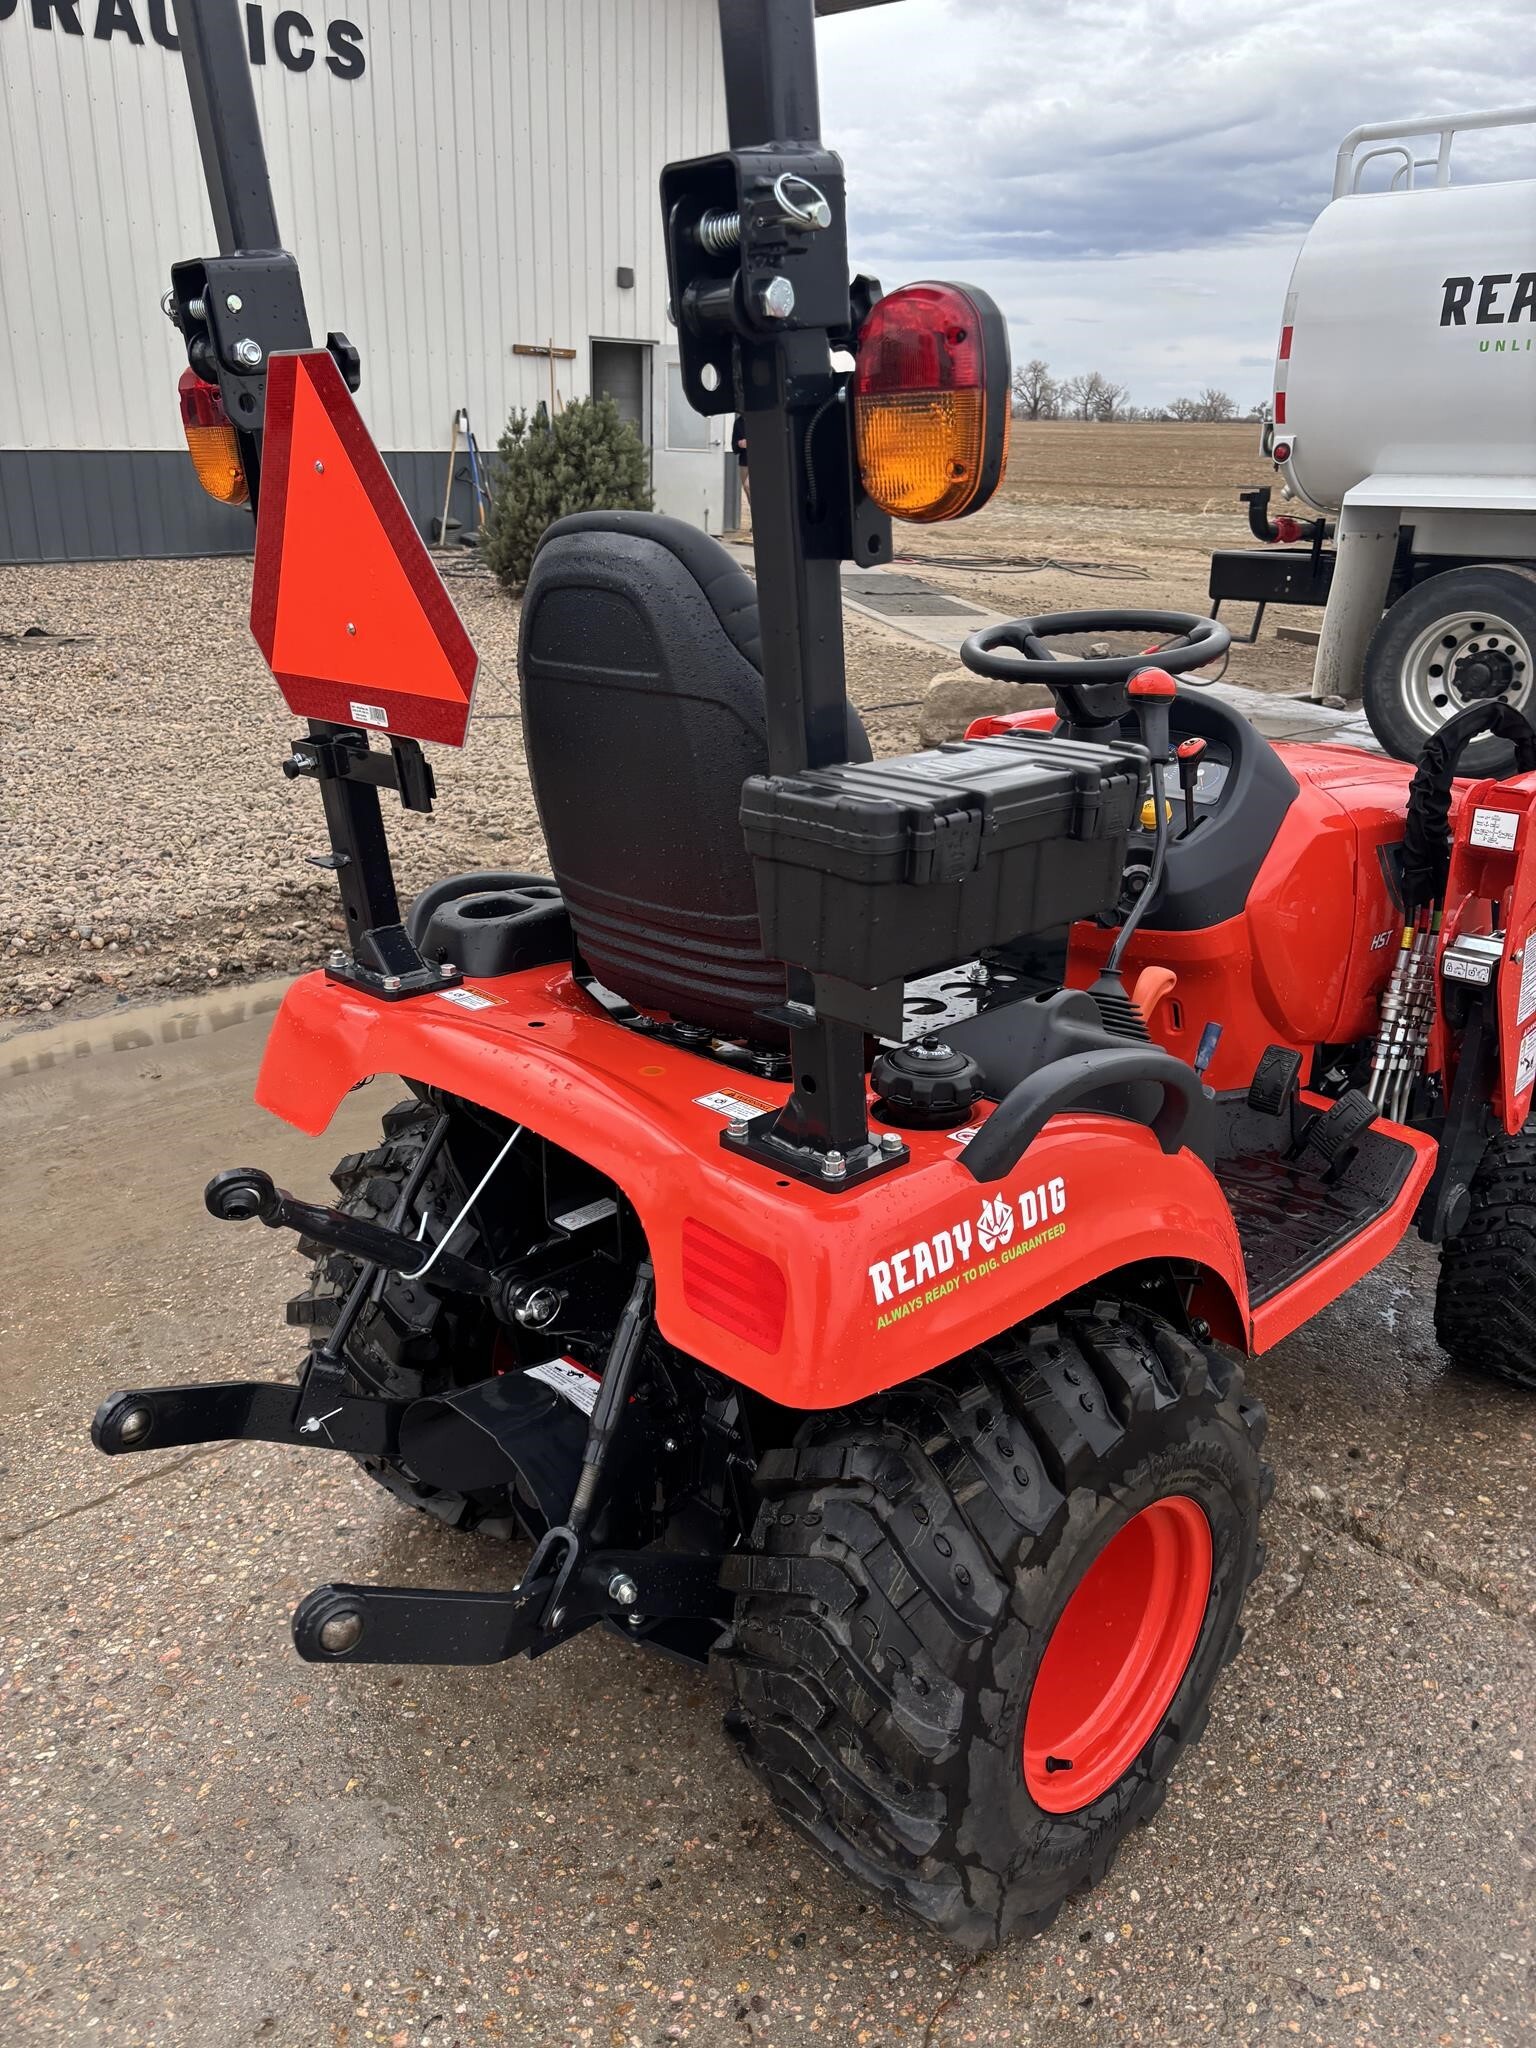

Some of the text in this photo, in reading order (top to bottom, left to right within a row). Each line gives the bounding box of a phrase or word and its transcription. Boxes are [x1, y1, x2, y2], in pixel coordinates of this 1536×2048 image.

[1370, 929, 1394, 951] HST
[868, 1176, 1067, 1306] READY DIG
[877, 1222, 1067, 1330] ALWAYS READY TO DIG. GUARANTEED
